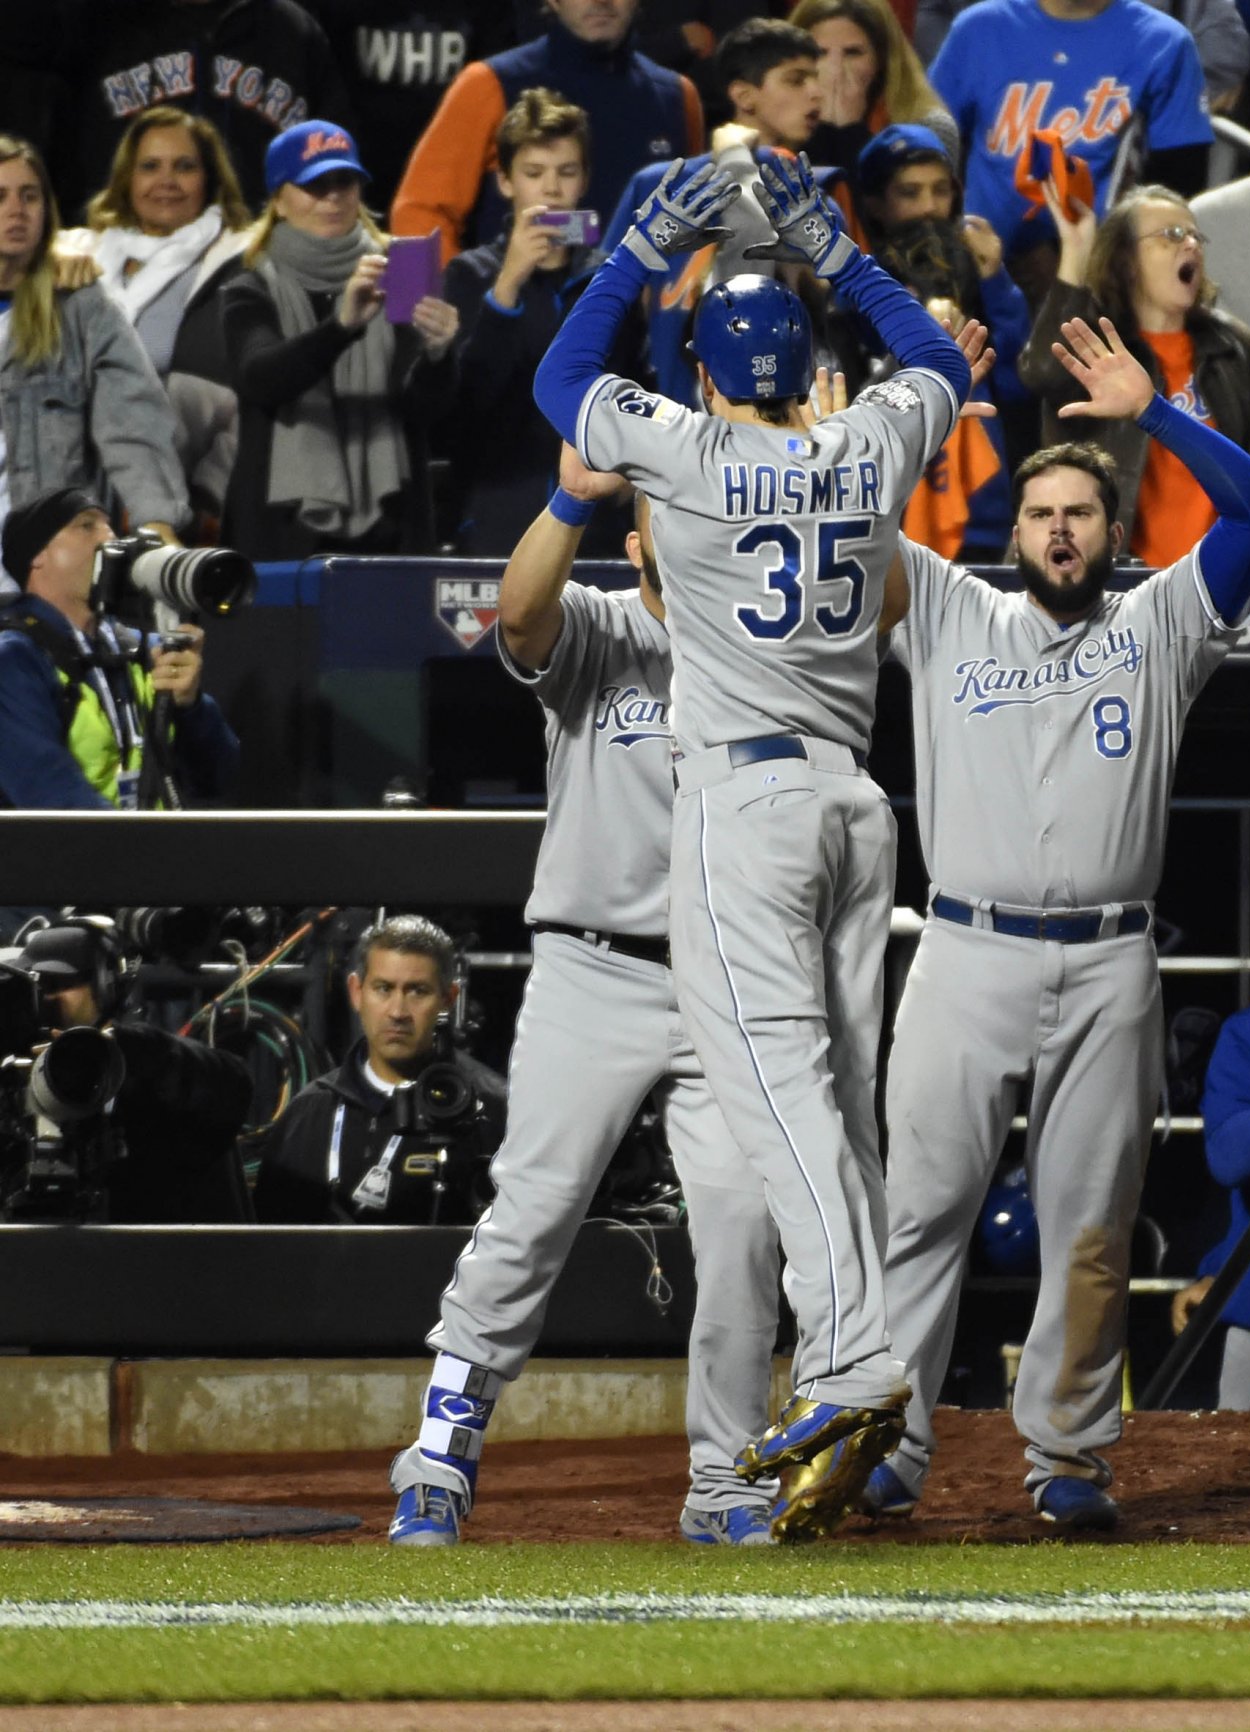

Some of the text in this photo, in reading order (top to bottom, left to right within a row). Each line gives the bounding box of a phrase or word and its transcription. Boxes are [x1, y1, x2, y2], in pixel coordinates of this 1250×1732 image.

[751, 354, 777, 376] 35
[721, 459, 882, 518] HOSMER
[440, 583, 498, 602] MLB
[731, 515, 876, 643] 35
[1073, 627, 1144, 679] City
[595, 685, 671, 732] Kan
[1093, 695, 1132, 760] 8
